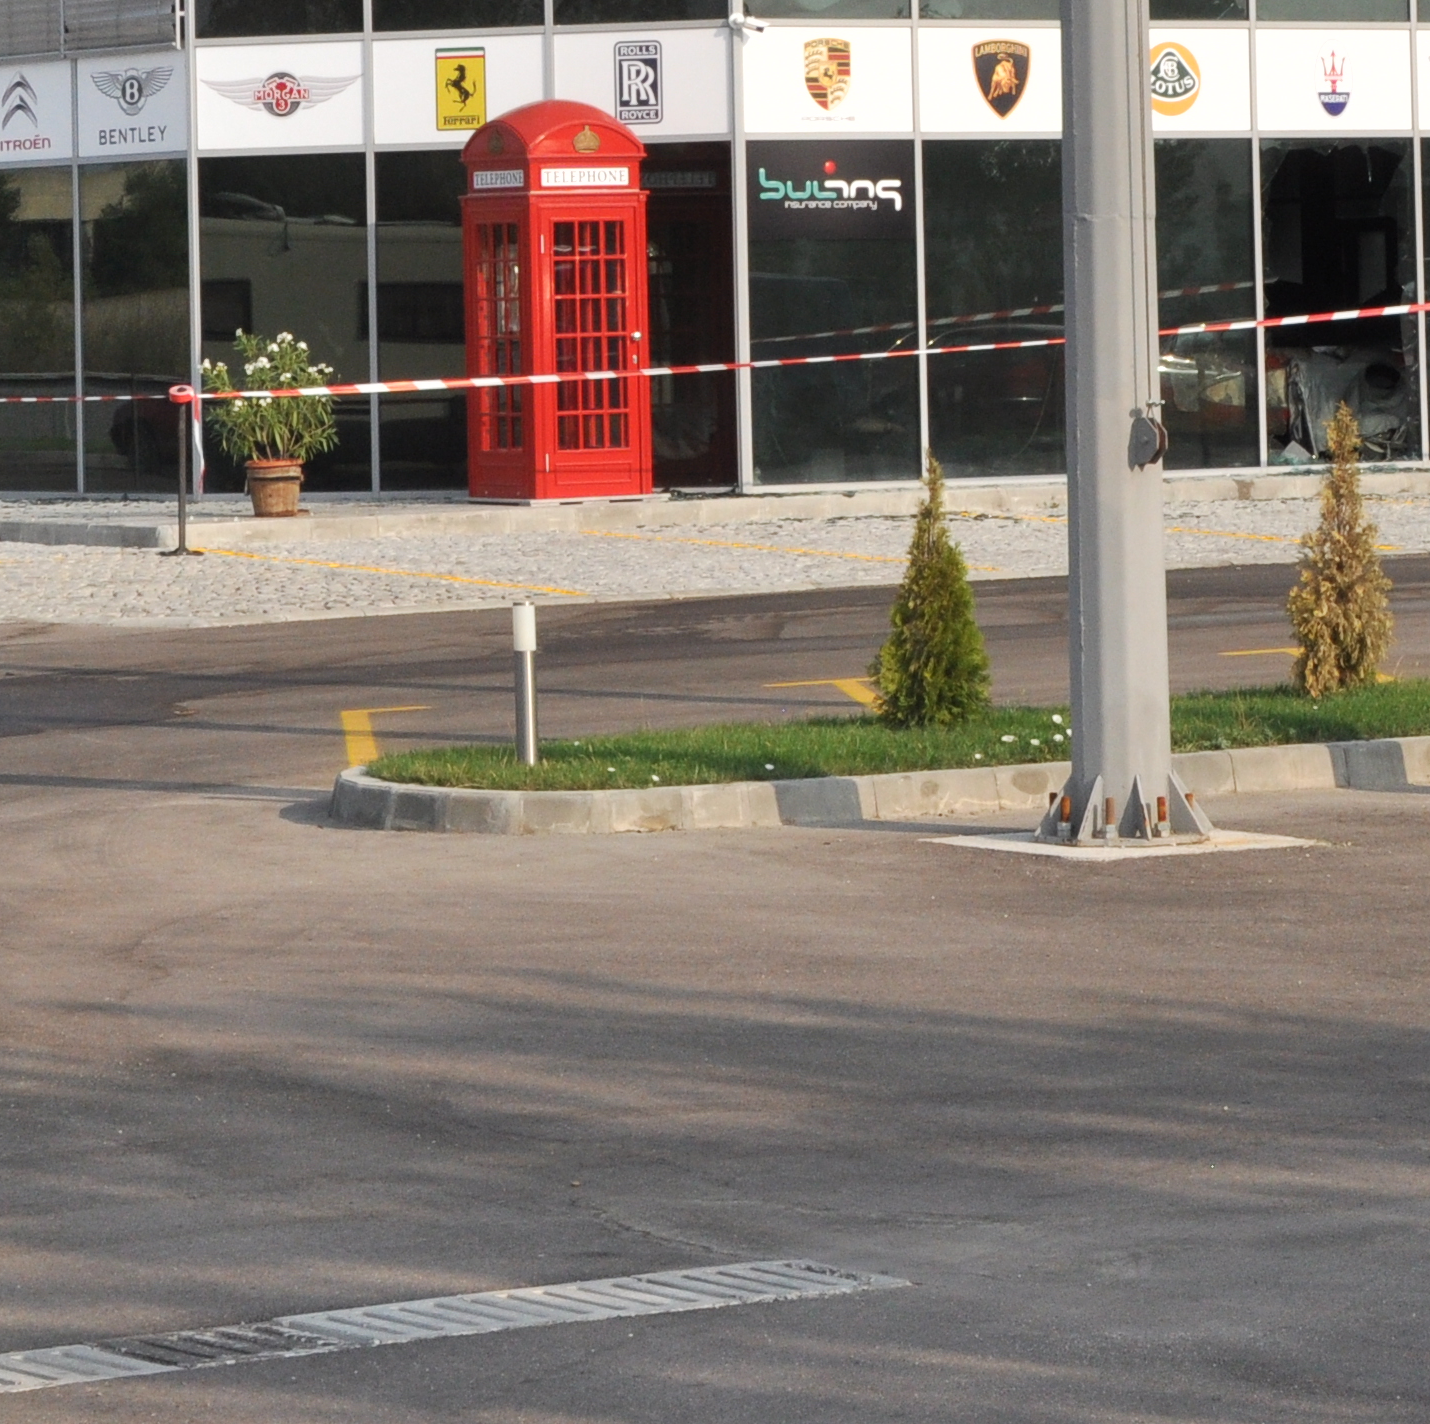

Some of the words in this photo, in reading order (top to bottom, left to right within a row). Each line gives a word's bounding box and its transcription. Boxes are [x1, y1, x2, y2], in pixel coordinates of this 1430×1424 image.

[620, 45, 656, 55] ROLLS
[975, 42, 1028, 57] LAMBORGHINI
[253, 86, 309, 101] MORGAN
[443, 116, 481, 126] Ferrari
[621, 109, 657, 120] ROYCE
[98, 125, 168, 146] BENTLEY
[474, 171, 524, 187] TELEPHONE
[544, 169, 627, 184] TELEPHONE
[784, 200, 832, 209] insurance
[833, 200, 878, 210] company
